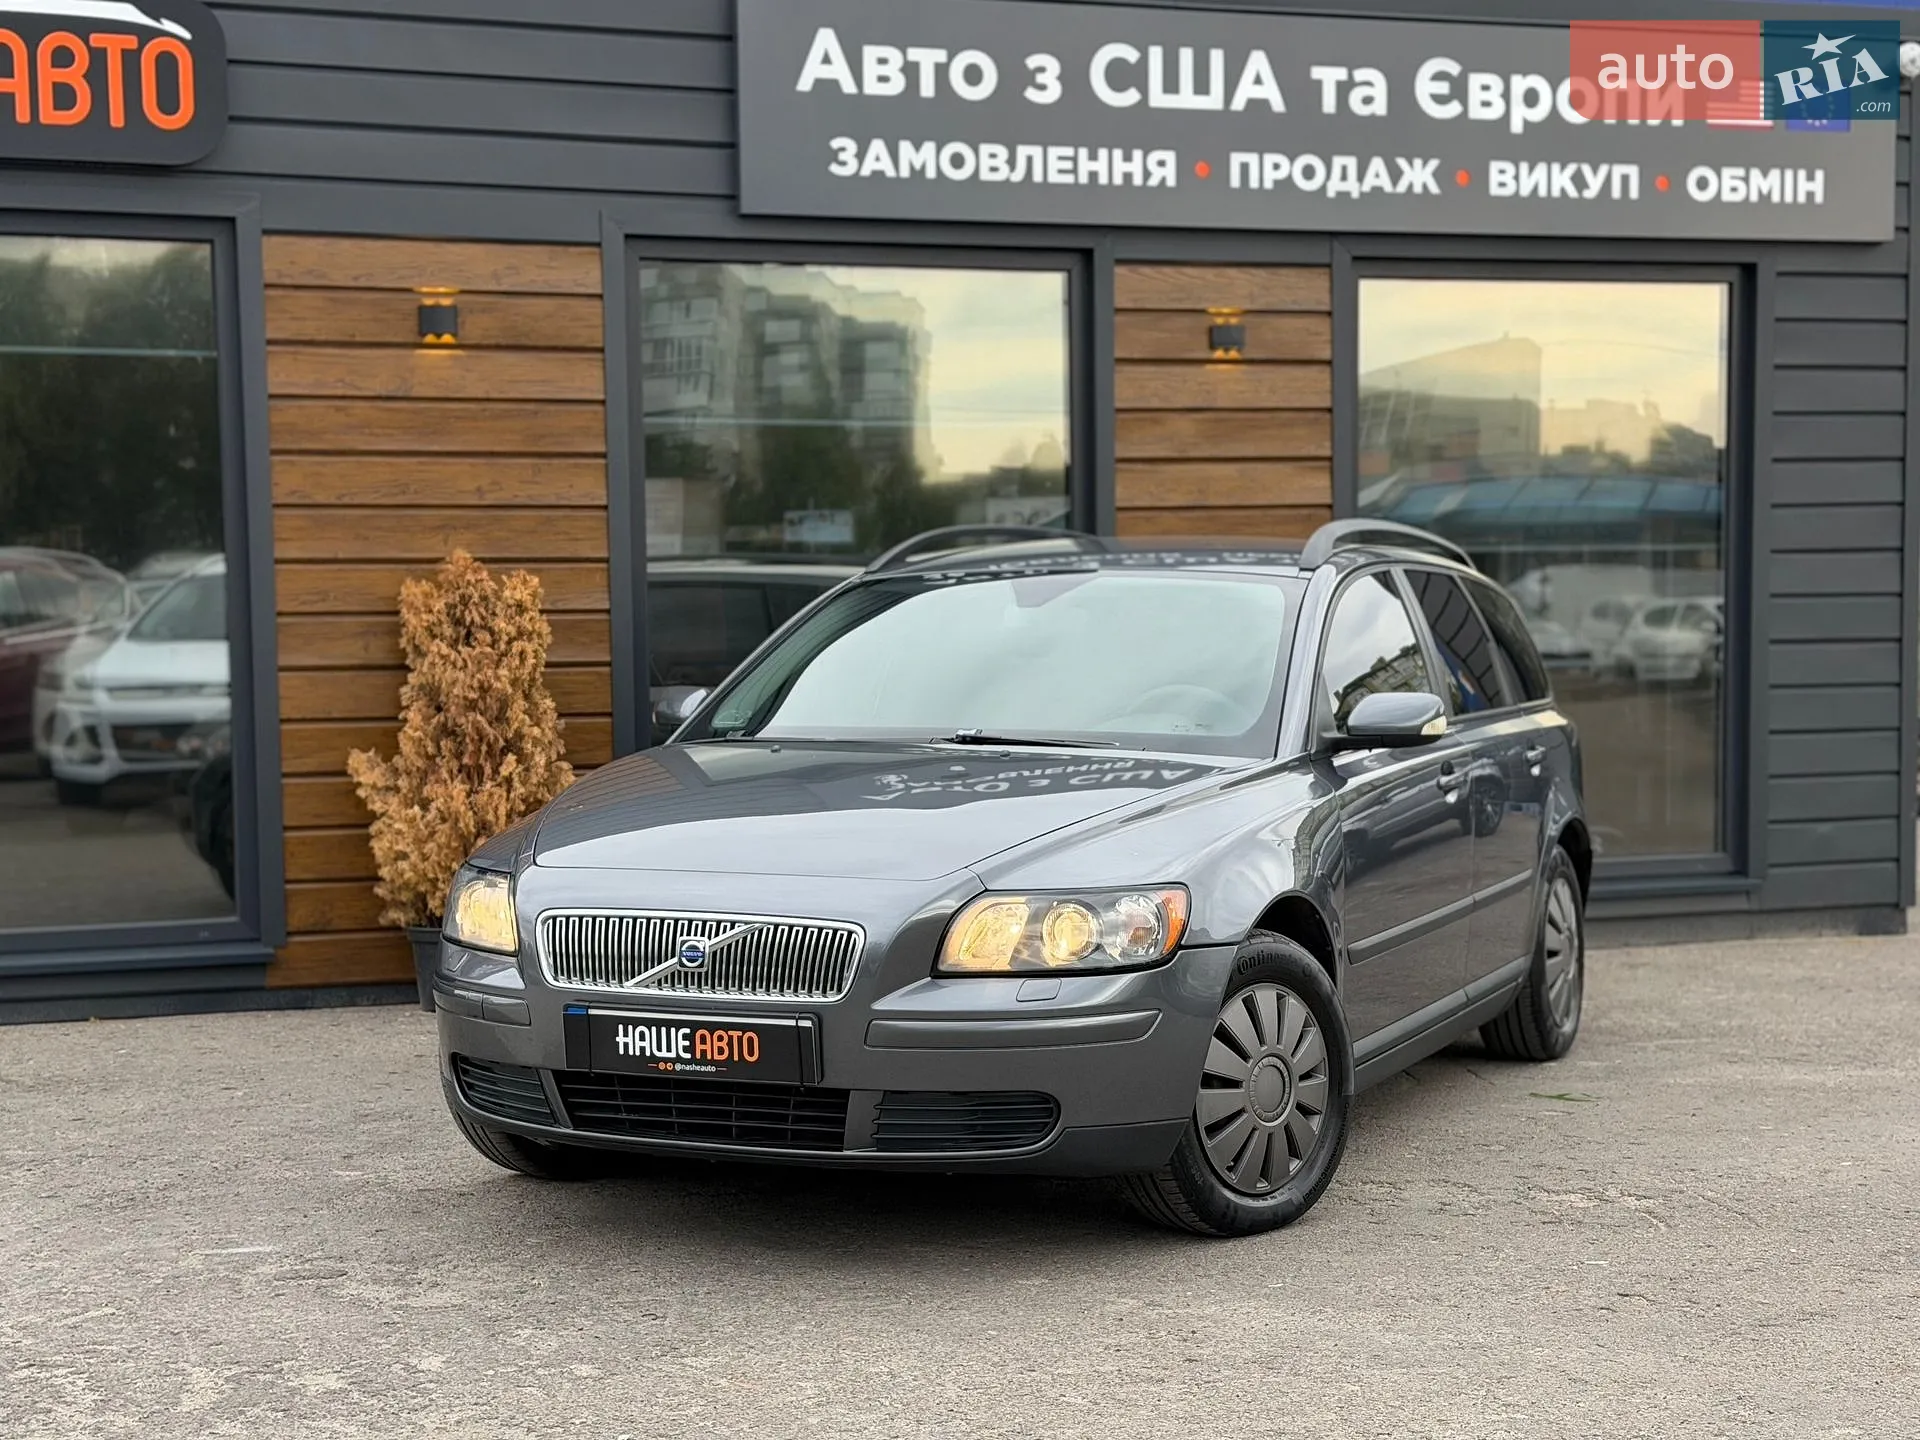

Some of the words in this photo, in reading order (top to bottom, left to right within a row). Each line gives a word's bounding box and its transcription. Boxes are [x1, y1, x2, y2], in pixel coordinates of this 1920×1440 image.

[0, 28, 195, 130] АВТО
[796, 27, 998, 101] Авто
[1024, 53, 1062, 104] з
[1089, 43, 1286, 113] США
[1310, 65, 1388, 116] та
[1414, 57, 1684, 134] Європи
[828, 137, 1176, 187] ЗАМОВЛЕННЯ
[1229, 151, 1441, 199] ПРОДАЖ
[1488, 160, 1640, 200] ВИКУП
[1686, 165, 1825, 204] ОБМІН
[616, 1024, 691, 1059] НАШЕ
[695, 1029, 760, 1062] АВТО
[675, 1062, 716, 1072] @nasheauto
